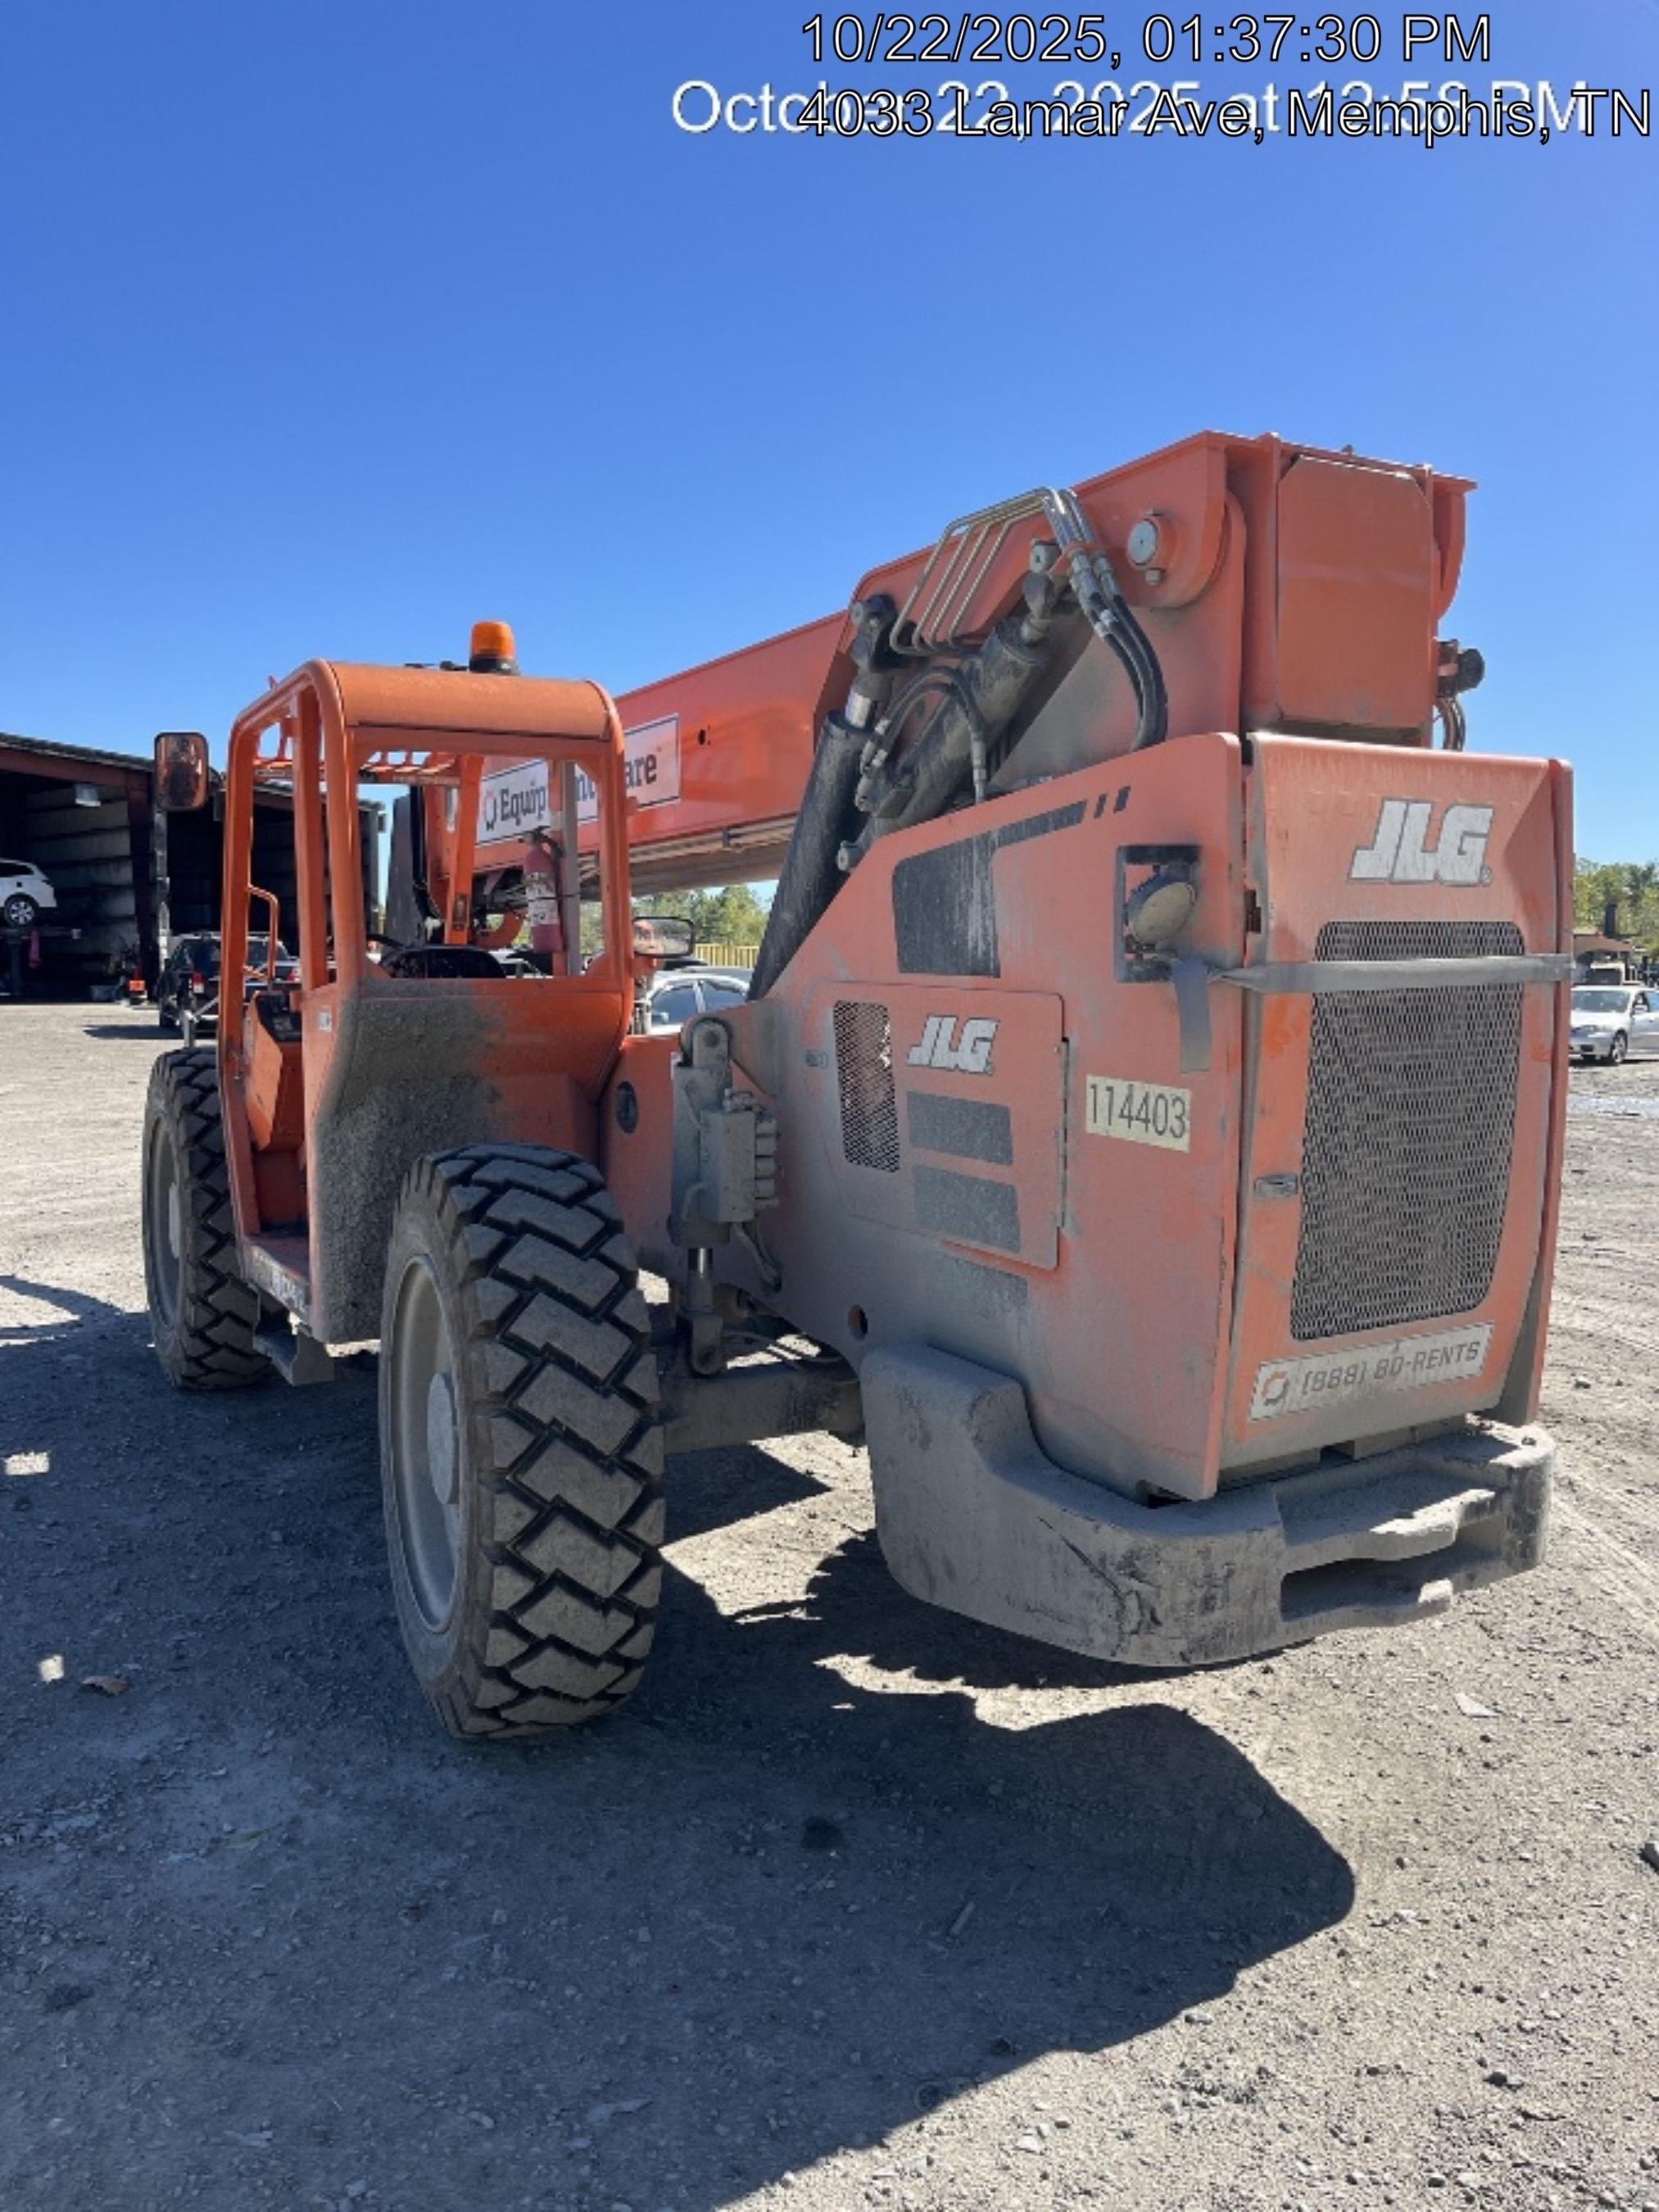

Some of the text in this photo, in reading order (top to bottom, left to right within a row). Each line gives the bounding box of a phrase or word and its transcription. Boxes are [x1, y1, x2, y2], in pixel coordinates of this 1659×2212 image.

[1347, 796, 1495, 888] JLG
[904, 1013, 999, 1077] JLG
[1090, 1083, 1186, 1139] 114403
